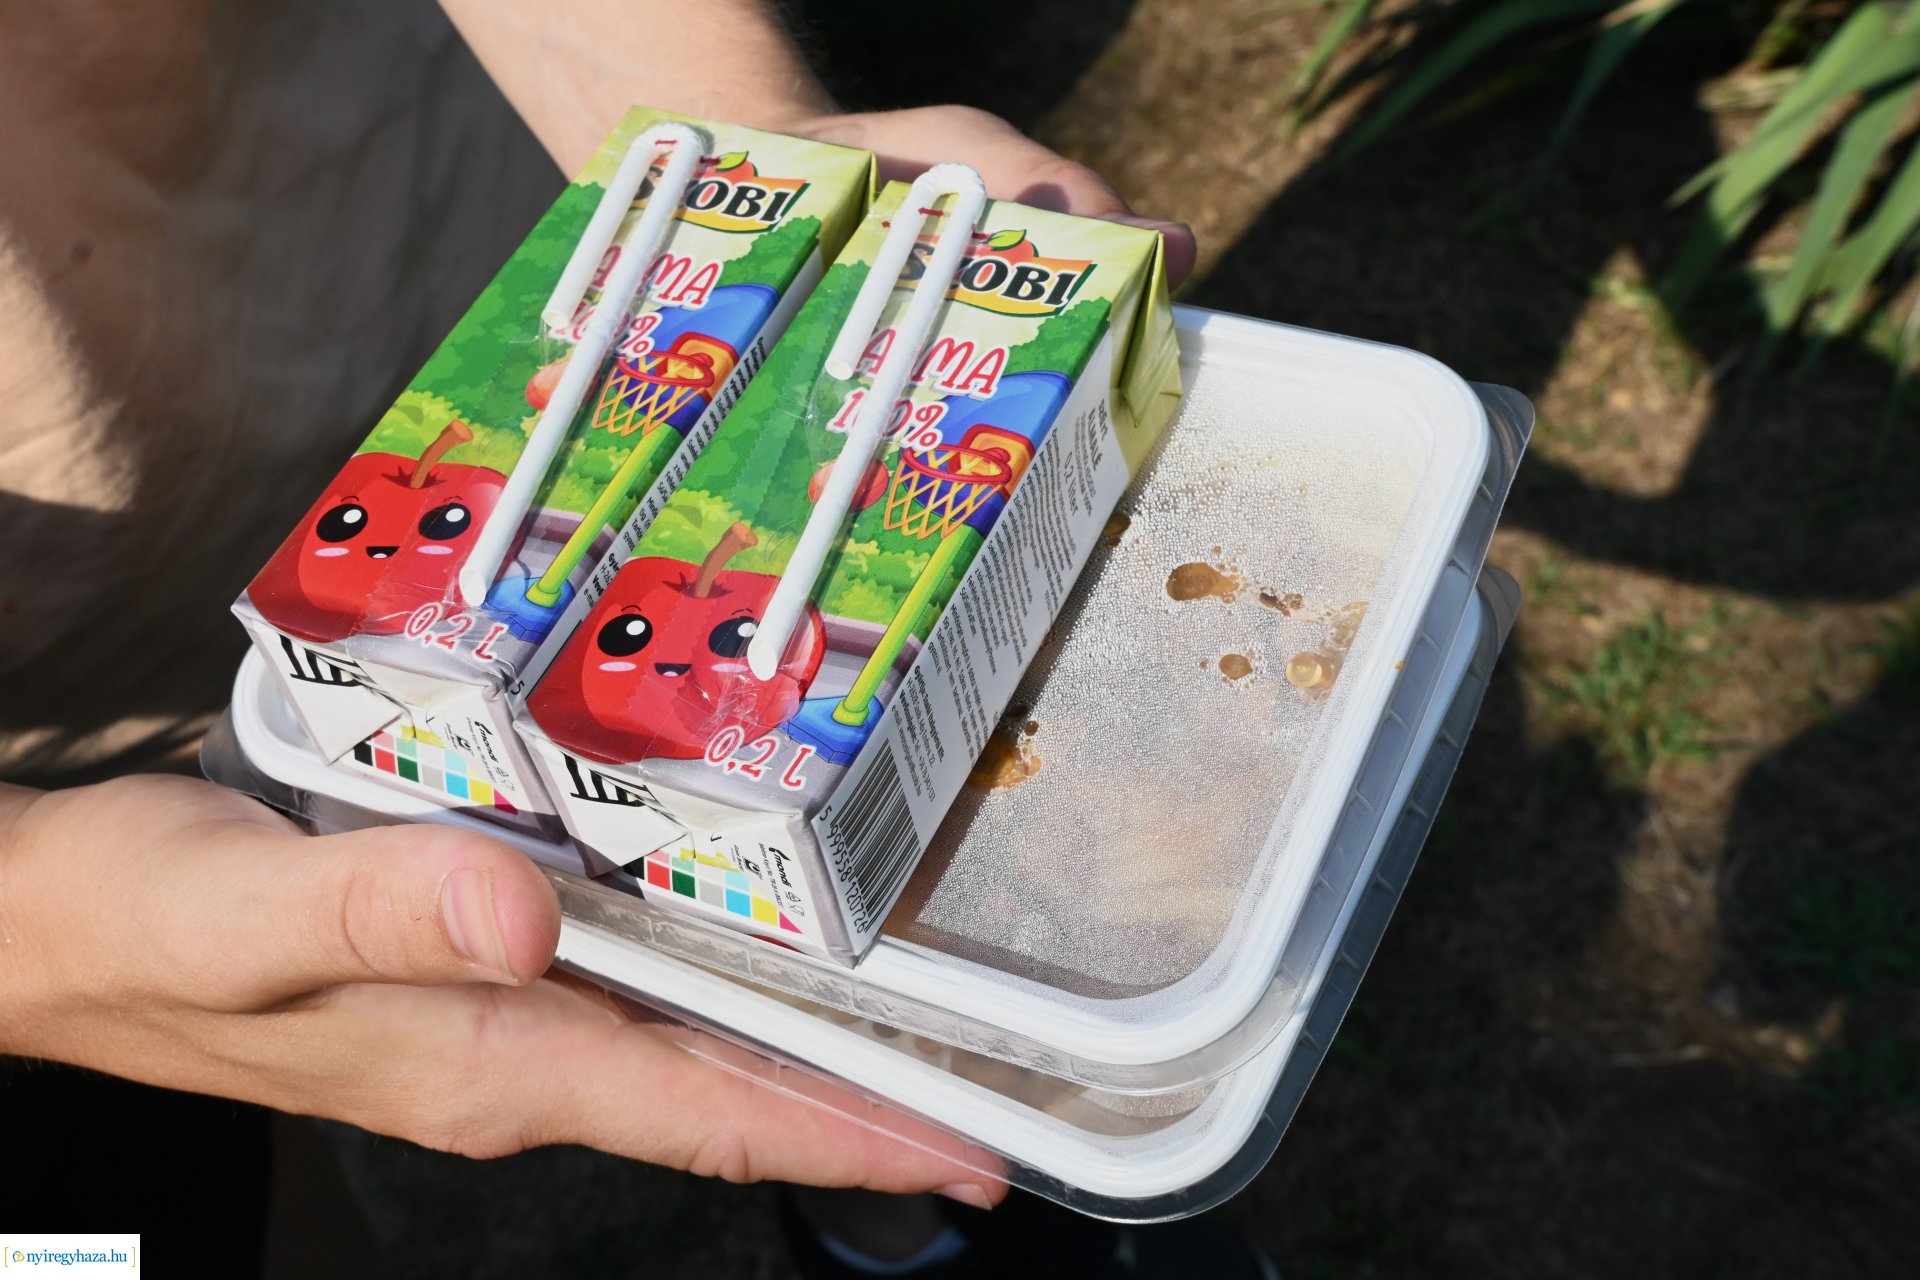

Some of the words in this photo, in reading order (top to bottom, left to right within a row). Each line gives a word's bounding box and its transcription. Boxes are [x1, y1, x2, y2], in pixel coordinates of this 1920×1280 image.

[632, 164, 791, 223] SOBI
[590, 244, 719, 305] AMA
[897, 240, 1078, 306] SOBI
[856, 327, 1006, 395] AMA
[832, 391, 944, 448] 10%
[1088, 407, 1103, 472] ALMALÉ
[1064, 451, 1074, 485] 0,2
[1067, 477, 1079, 516] liter
[406, 604, 473, 650] 0,2
[707, 728, 778, 778] 0,2
[774, 852, 793, 888] mondi
[819, 805, 832, 822] 5
[827, 824, 852, 882] 999558
[845, 881, 869, 934] 120726
